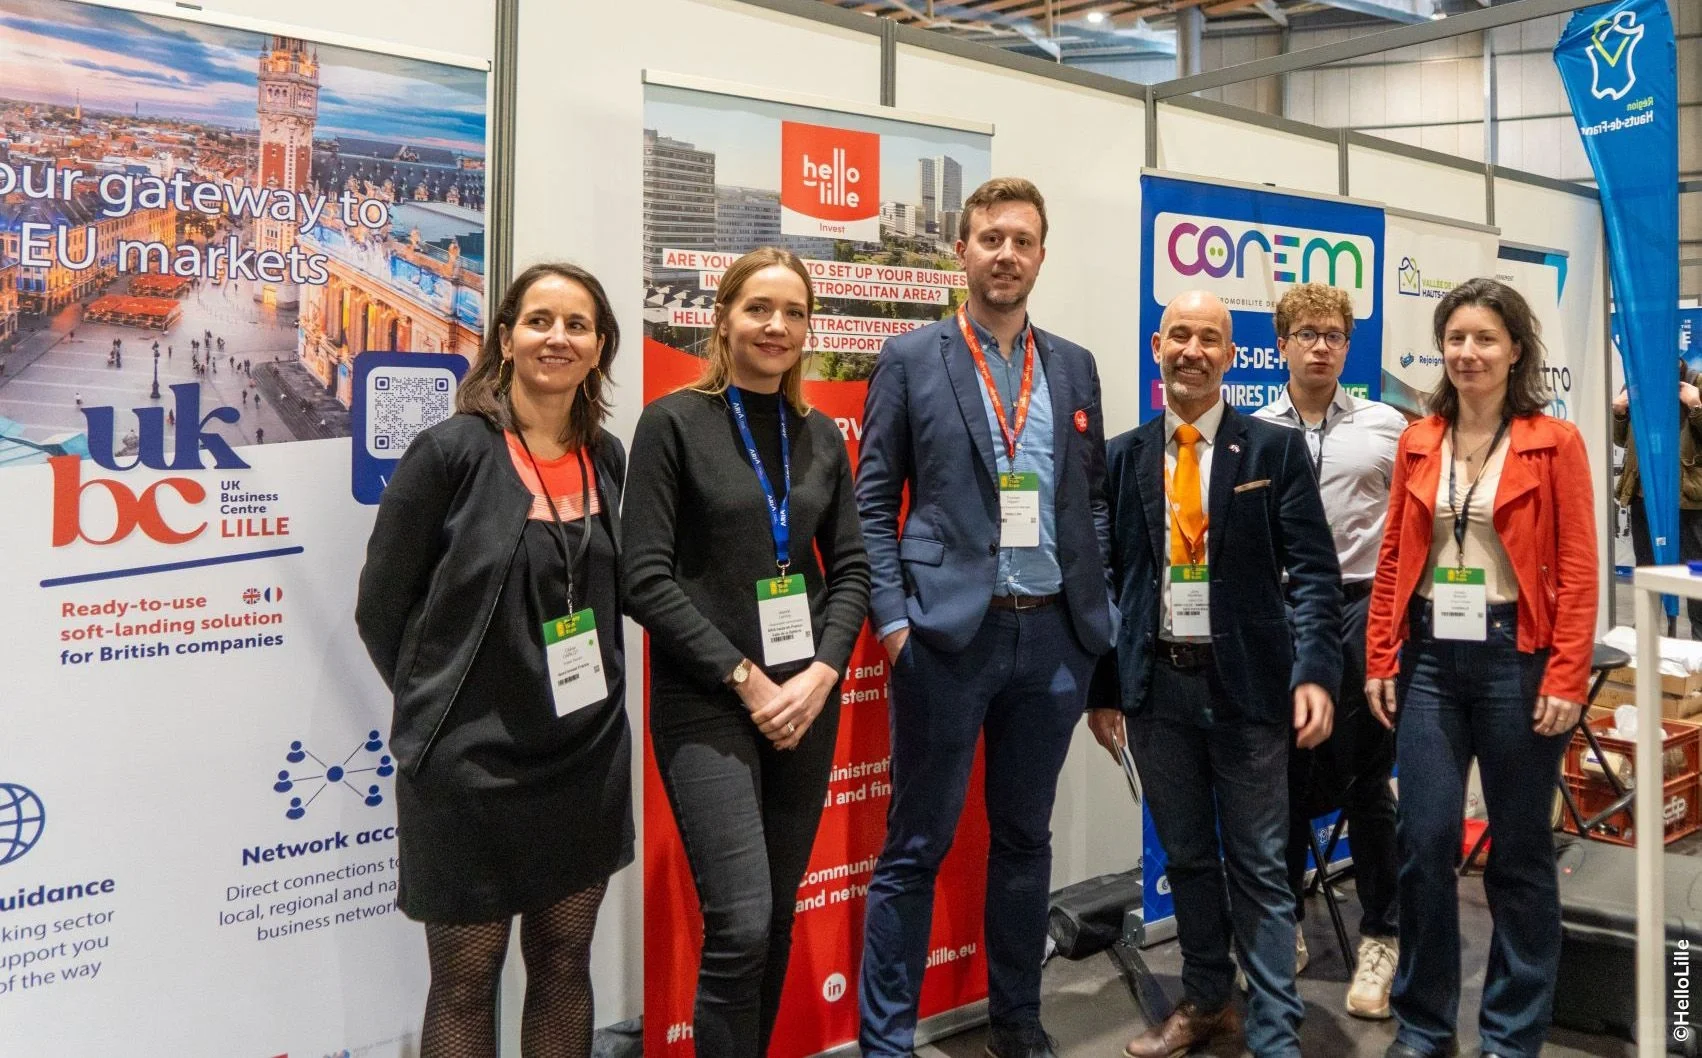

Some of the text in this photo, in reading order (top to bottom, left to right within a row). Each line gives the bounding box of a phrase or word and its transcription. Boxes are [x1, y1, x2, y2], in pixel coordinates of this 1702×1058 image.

[803, 148, 861, 185] hello
[0, 161, 389, 235] our gateway to
[819, 182, 860, 208] lille
[819, 223, 846, 234] Invest
[21, 221, 329, 284] EU markets
[666, 252, 967, 287] ARE YOU TO SET UP YOUR BUSINES
[705, 274, 720, 287] IN
[902, 288, 942, 302] AREA?
[823, 336, 882, 350] SUPPORT
[81, 383, 251, 471] uk
[221, 480, 241, 490] UK
[221, 492, 279, 503] Business
[47, 454, 208, 547] bc
[220, 505, 267, 514] Centre
[221, 517, 290, 537] LILLE
[62, 596, 207, 617] Ready-to-use
[60, 611, 283, 642] soft-landing solution
[60, 633, 284, 665] for British companies
[855, 660, 884, 680] and
[836, 785, 866, 805] and
[242, 831, 349, 866] Network
[226, 880, 279, 902] Direct
[283, 859, 385, 890] connections
[0, 879, 115, 912] uidance
[219, 904, 264, 927] local,
[270, 888, 338, 915] regional
[343, 882, 373, 900] and
[795, 889, 826, 913] and
[2, 910, 115, 941] king sector
[257, 916, 330, 941] business
[72, 936, 109, 958] you
[0, 961, 102, 994] of the way
